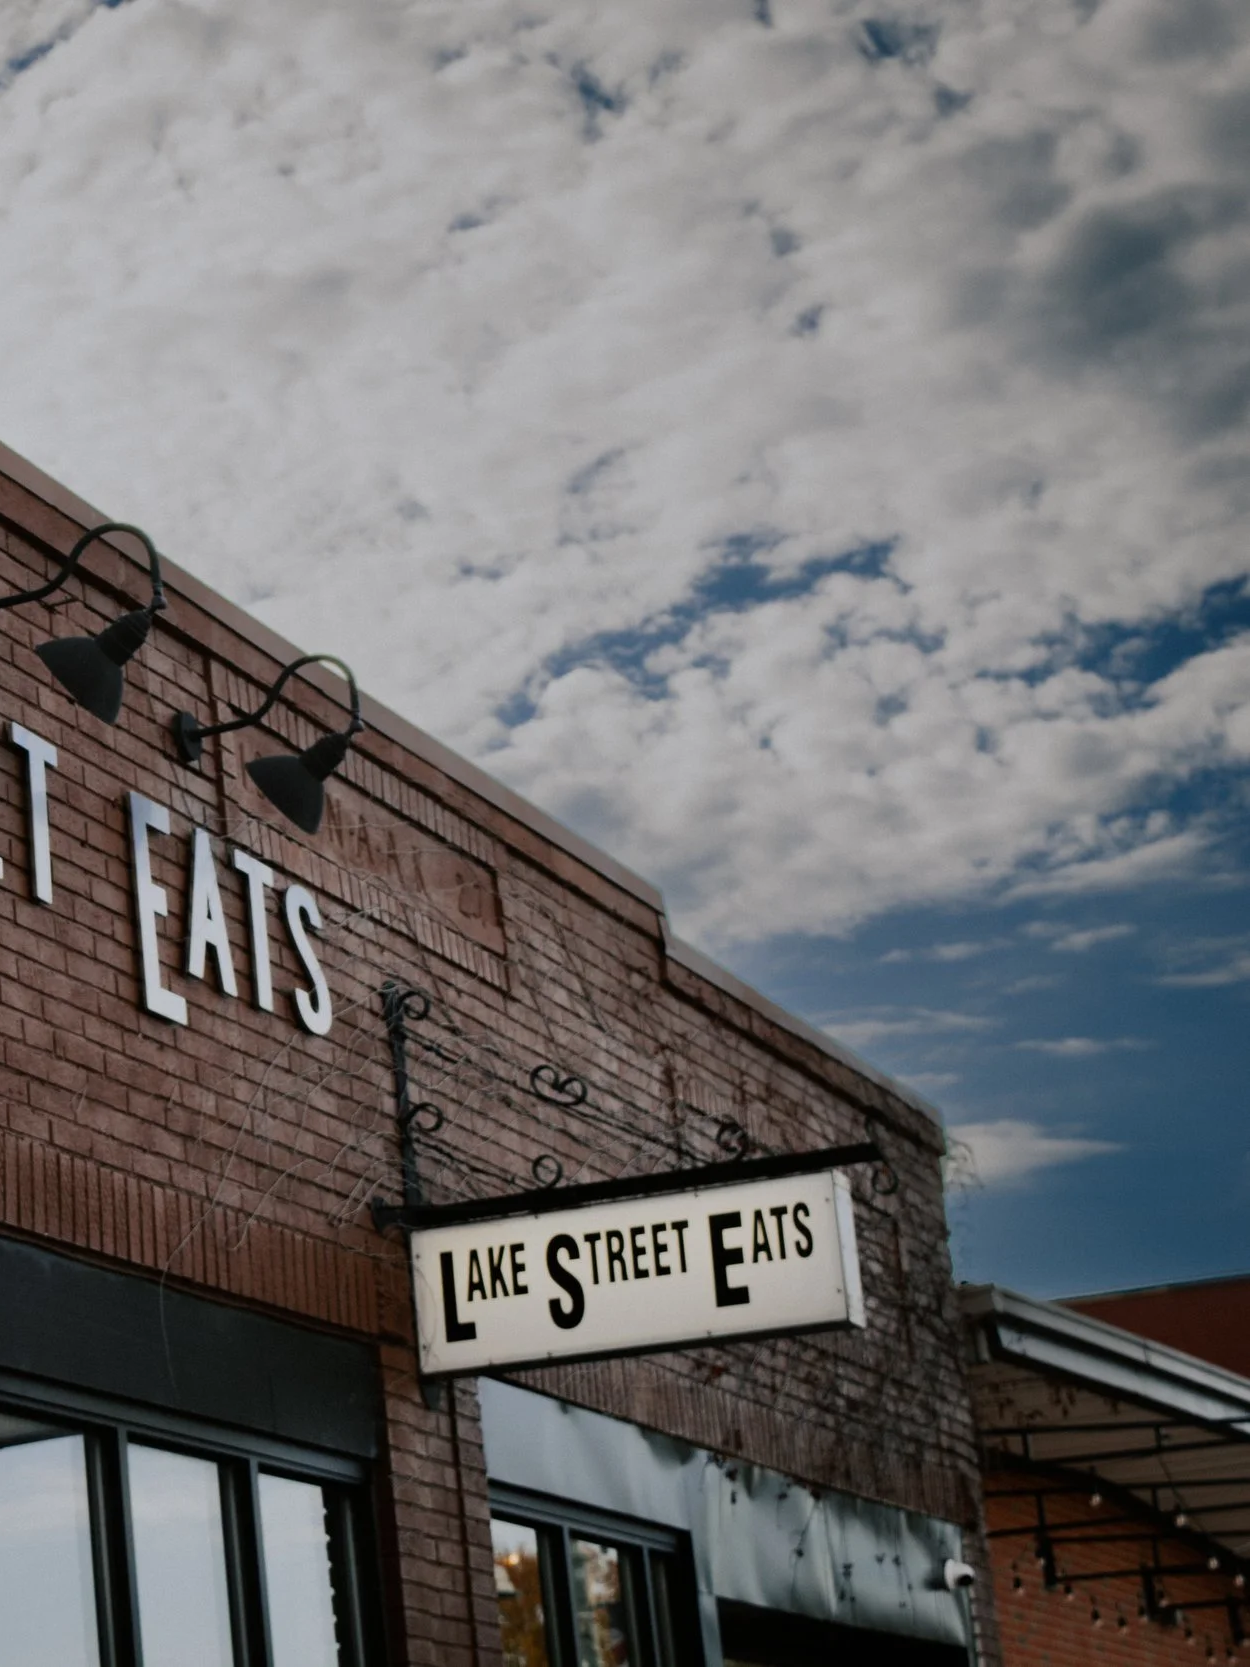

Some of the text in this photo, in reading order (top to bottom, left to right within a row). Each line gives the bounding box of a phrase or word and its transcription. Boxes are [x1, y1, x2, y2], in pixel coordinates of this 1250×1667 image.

[125, 790, 333, 1036] EATS
[440, 1201, 815, 1342] LAKE STREET EATS
